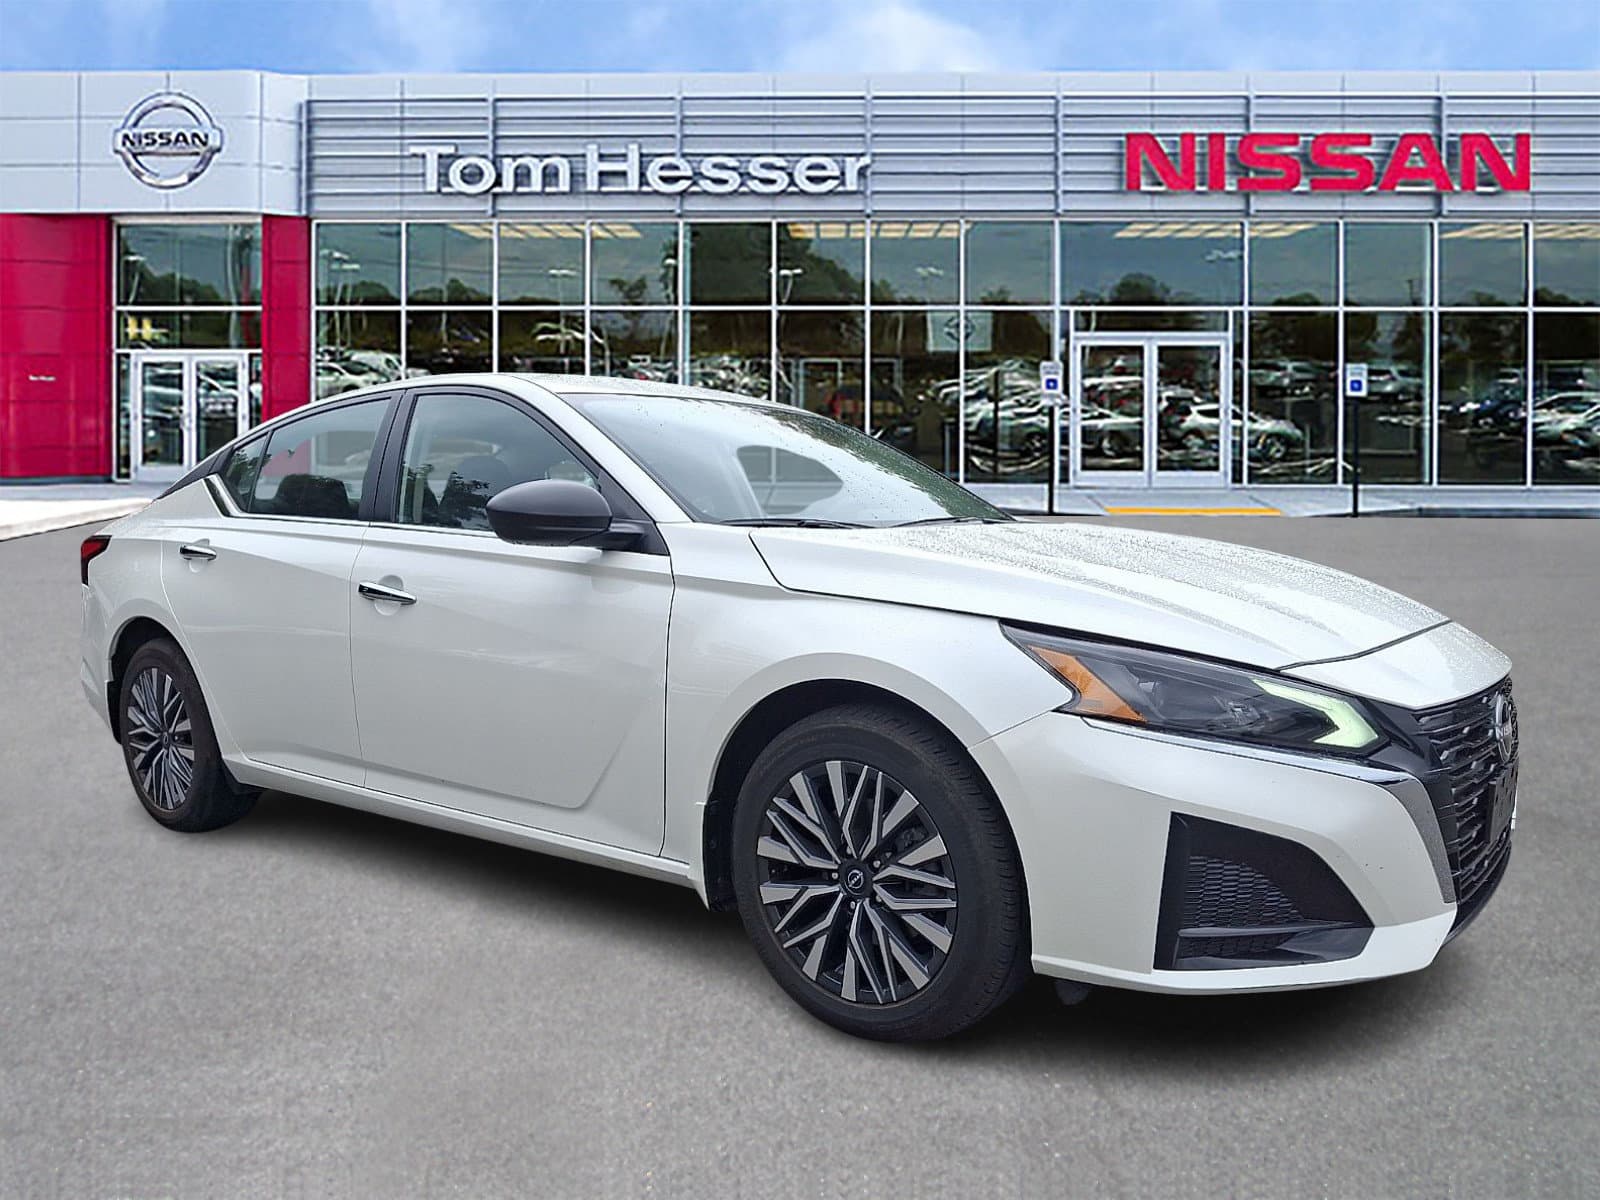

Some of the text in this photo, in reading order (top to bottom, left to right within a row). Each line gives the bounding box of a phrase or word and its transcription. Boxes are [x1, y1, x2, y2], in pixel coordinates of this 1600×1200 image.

[122, 131, 209, 147] NISSAN
[1124, 132, 1531, 191] NISSAN
[409, 143, 871, 194] Tom Hesser
